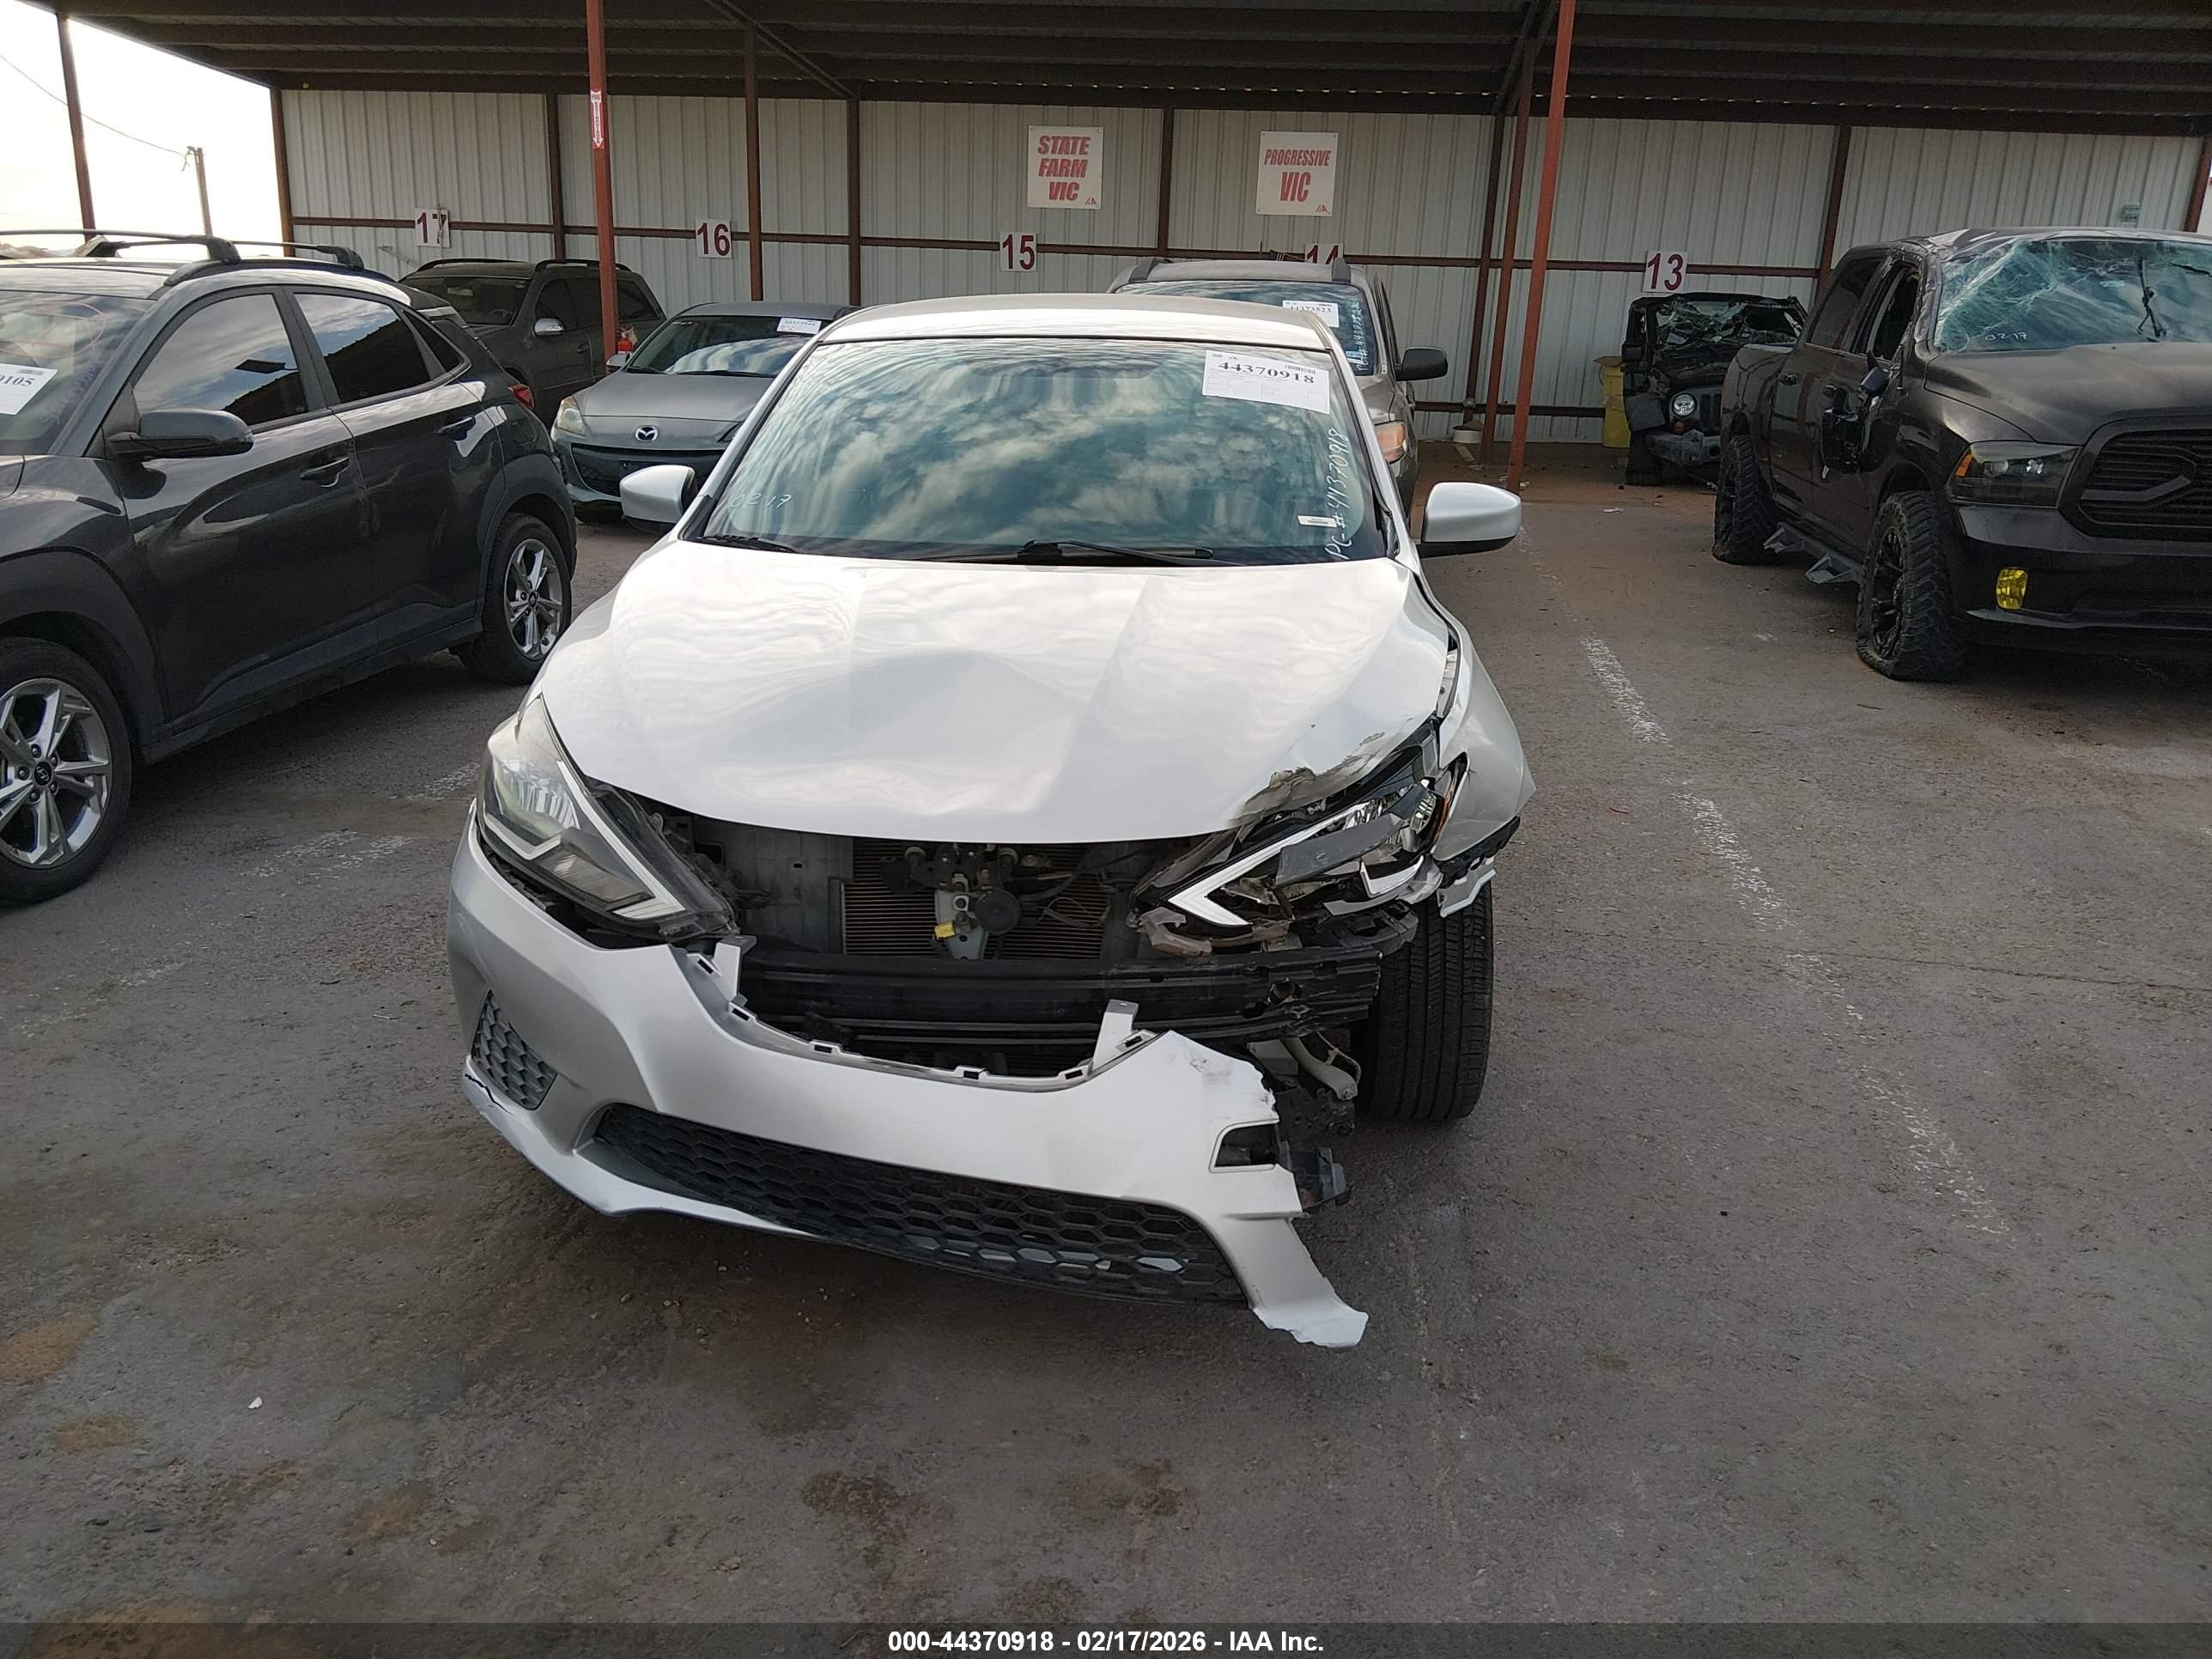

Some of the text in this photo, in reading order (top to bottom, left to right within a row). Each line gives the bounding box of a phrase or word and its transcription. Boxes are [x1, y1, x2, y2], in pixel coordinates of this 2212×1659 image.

[1037, 136, 1091, 155] STATE
[1264, 149, 1331, 166] PROGRESSIVE
[1037, 158, 1088, 179] FARM
[1048, 181, 1079, 201] VIC
[1279, 172, 1311, 202] VIC
[417, 212, 447, 244] 17
[697, 222, 730, 256] 16
[1002, 234, 1036, 270] 15
[1647, 252, 1684, 290] 13
[1218, 362, 1315, 384] 44370918
